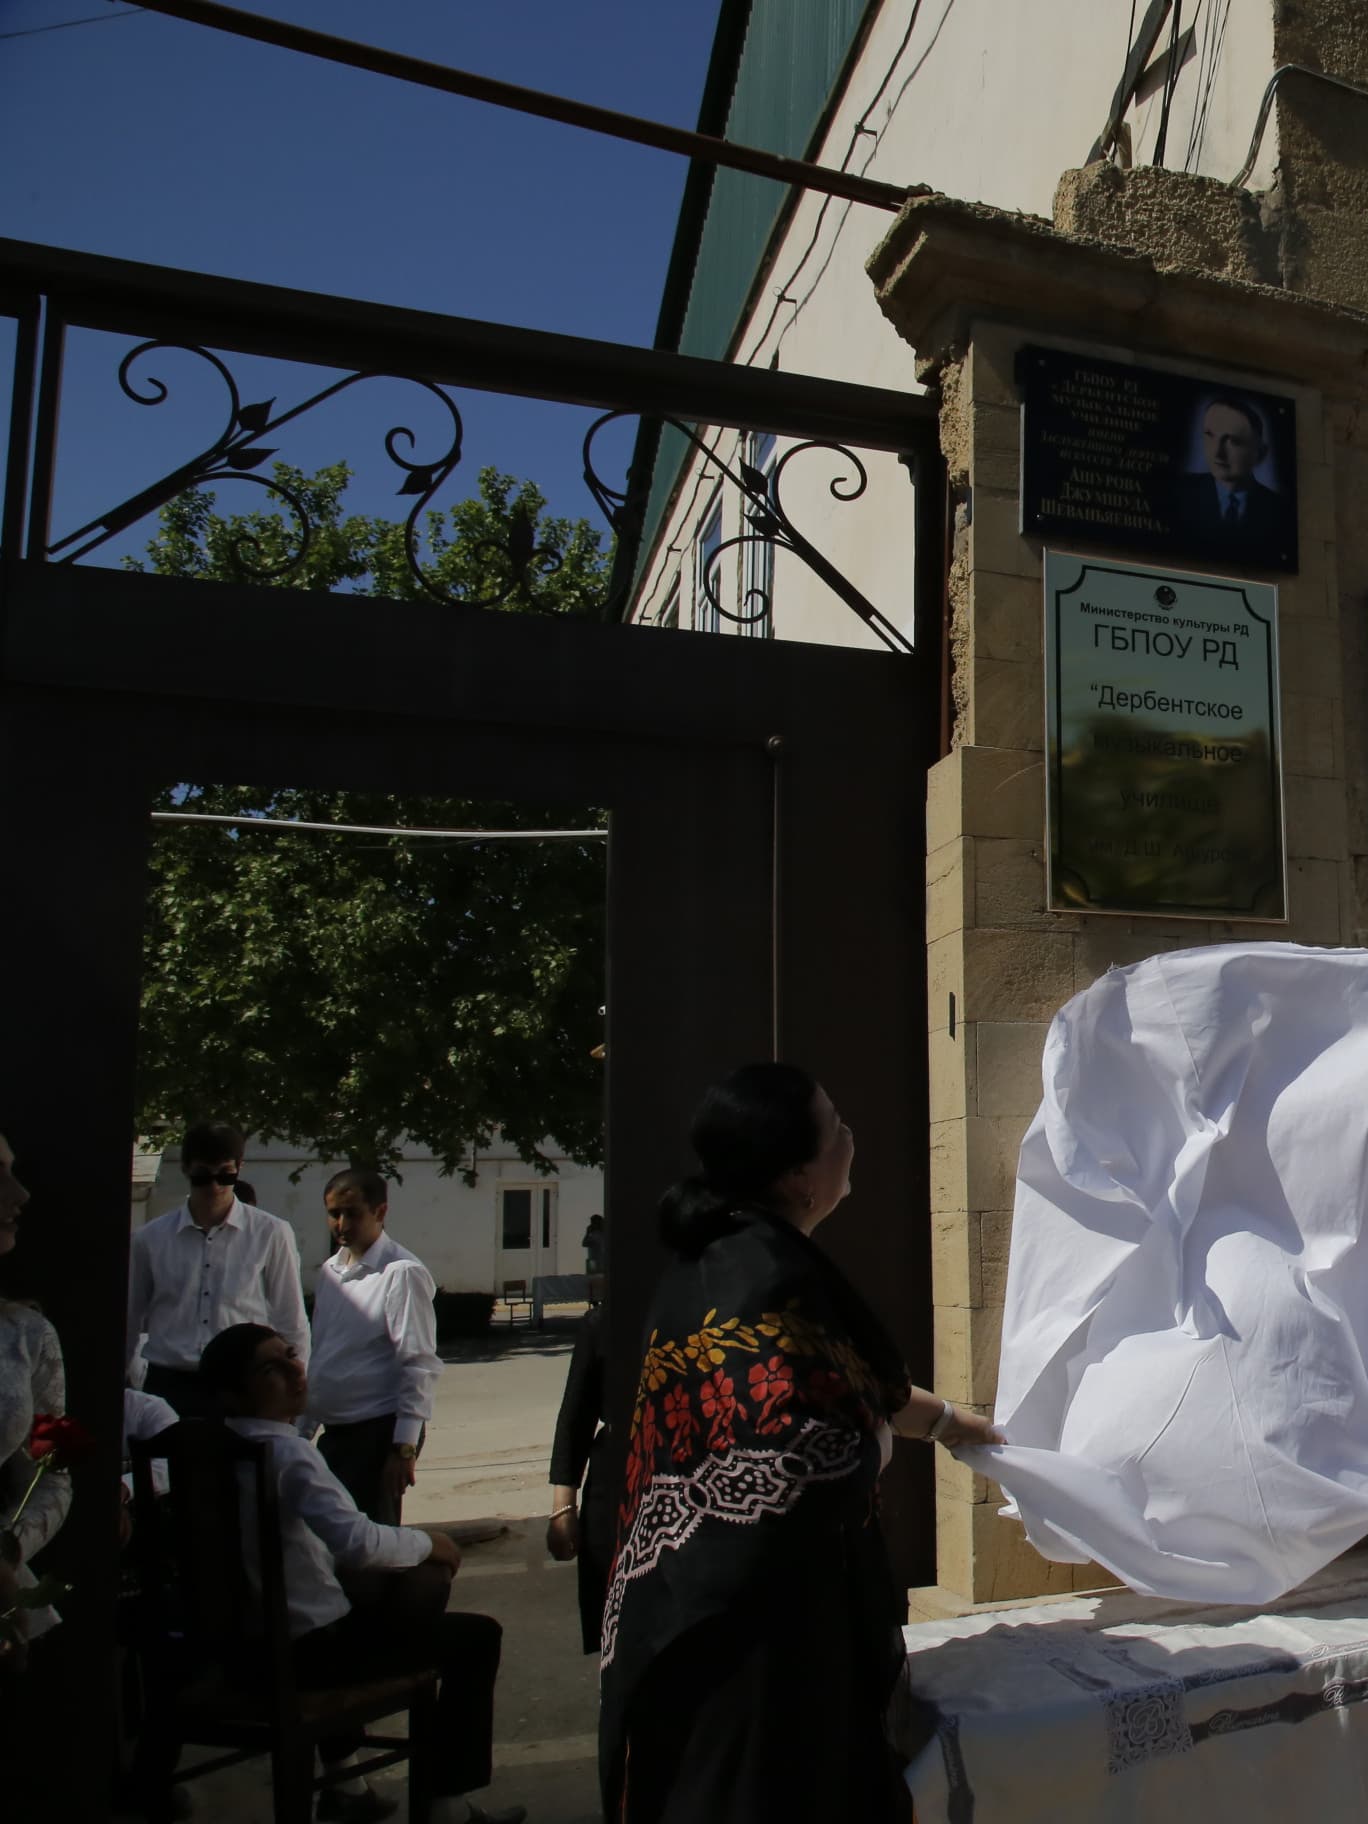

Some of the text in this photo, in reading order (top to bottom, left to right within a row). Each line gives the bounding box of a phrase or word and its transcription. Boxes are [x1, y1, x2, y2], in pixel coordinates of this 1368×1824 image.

[1080, 601, 1249, 637] Министерство культуры РД
[1093, 623, 1239, 670] ГБПОУ РД
